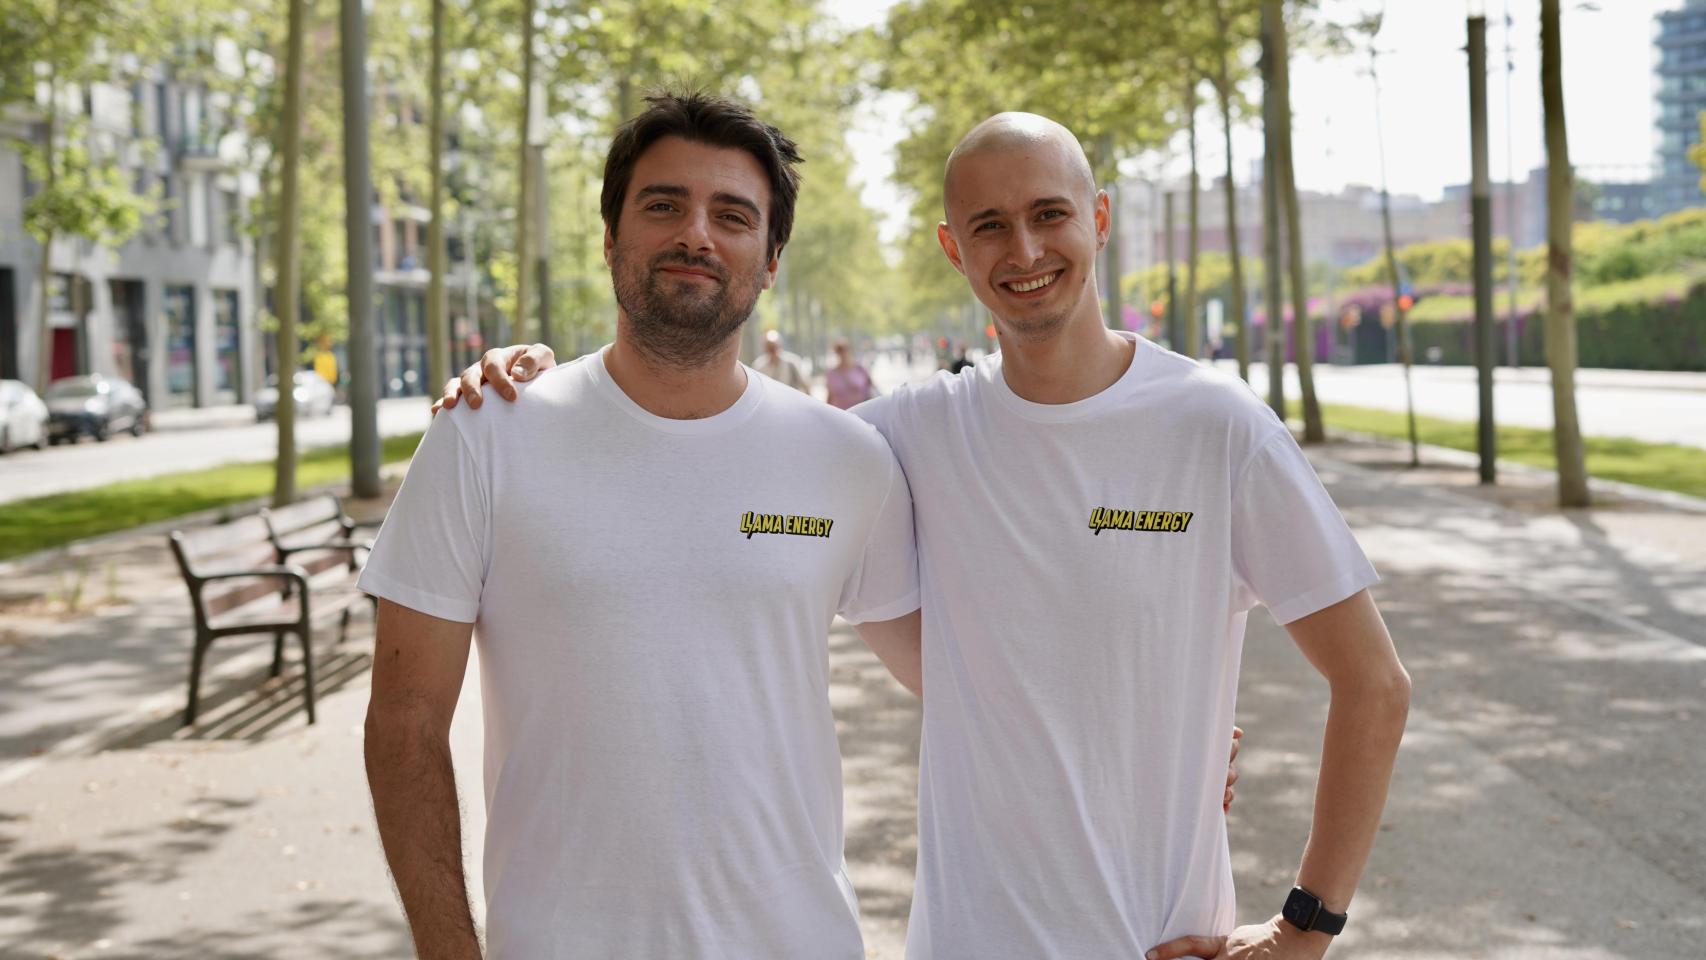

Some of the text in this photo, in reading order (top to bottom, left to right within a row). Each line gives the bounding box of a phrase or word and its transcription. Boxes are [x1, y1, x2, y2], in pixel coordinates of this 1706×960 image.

[740, 511, 833, 539] LLAMA ENERGY
[1089, 507, 1193, 535] LLAMA ENERGY
